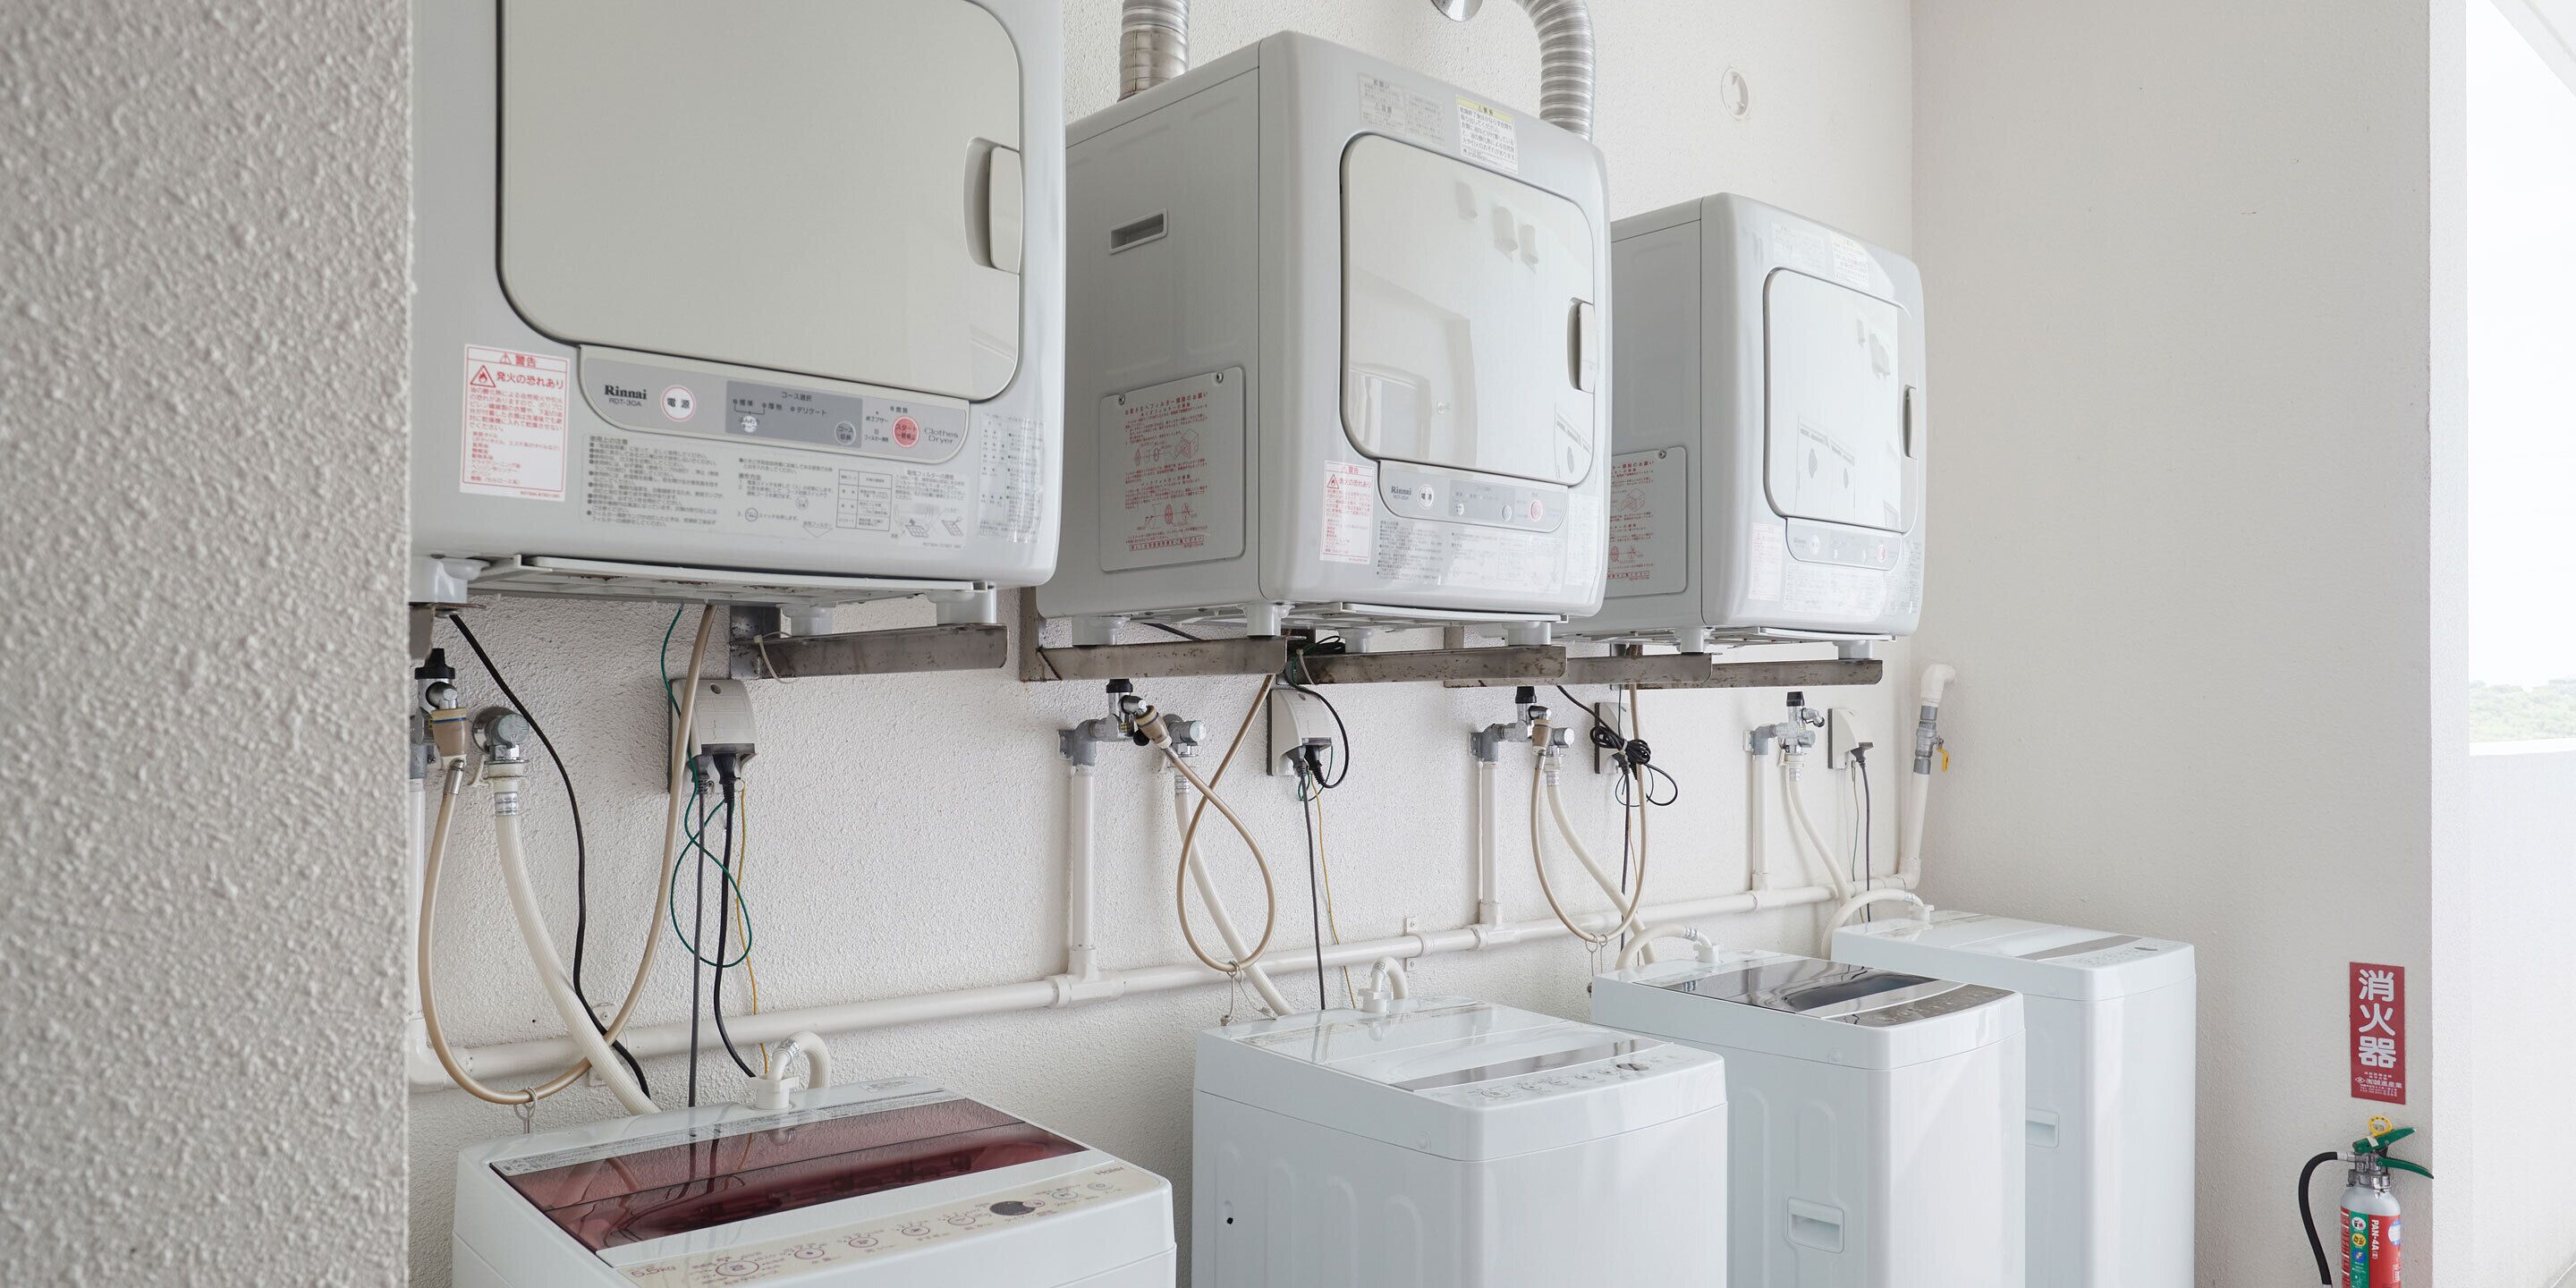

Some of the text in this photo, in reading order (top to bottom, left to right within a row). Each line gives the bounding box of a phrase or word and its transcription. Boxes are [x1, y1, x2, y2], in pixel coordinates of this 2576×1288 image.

[515, 354, 537, 368] 警告
[496, 371, 564, 390] 発火の恐れあり
[605, 385, 647, 400] Rinnai
[782, 391, 812, 402] コース選択
[667, 397, 690, 409] 電源
[796, 406, 827, 416] デリケート
[924, 427, 959, 438] Clothes
[928, 435, 953, 445] Dryer
[1391, 486, 1411, 496] Rinnai
[2359, 969, 2396, 1069] 消火器
[631, 1266, 676, 1278] 5.5kg
